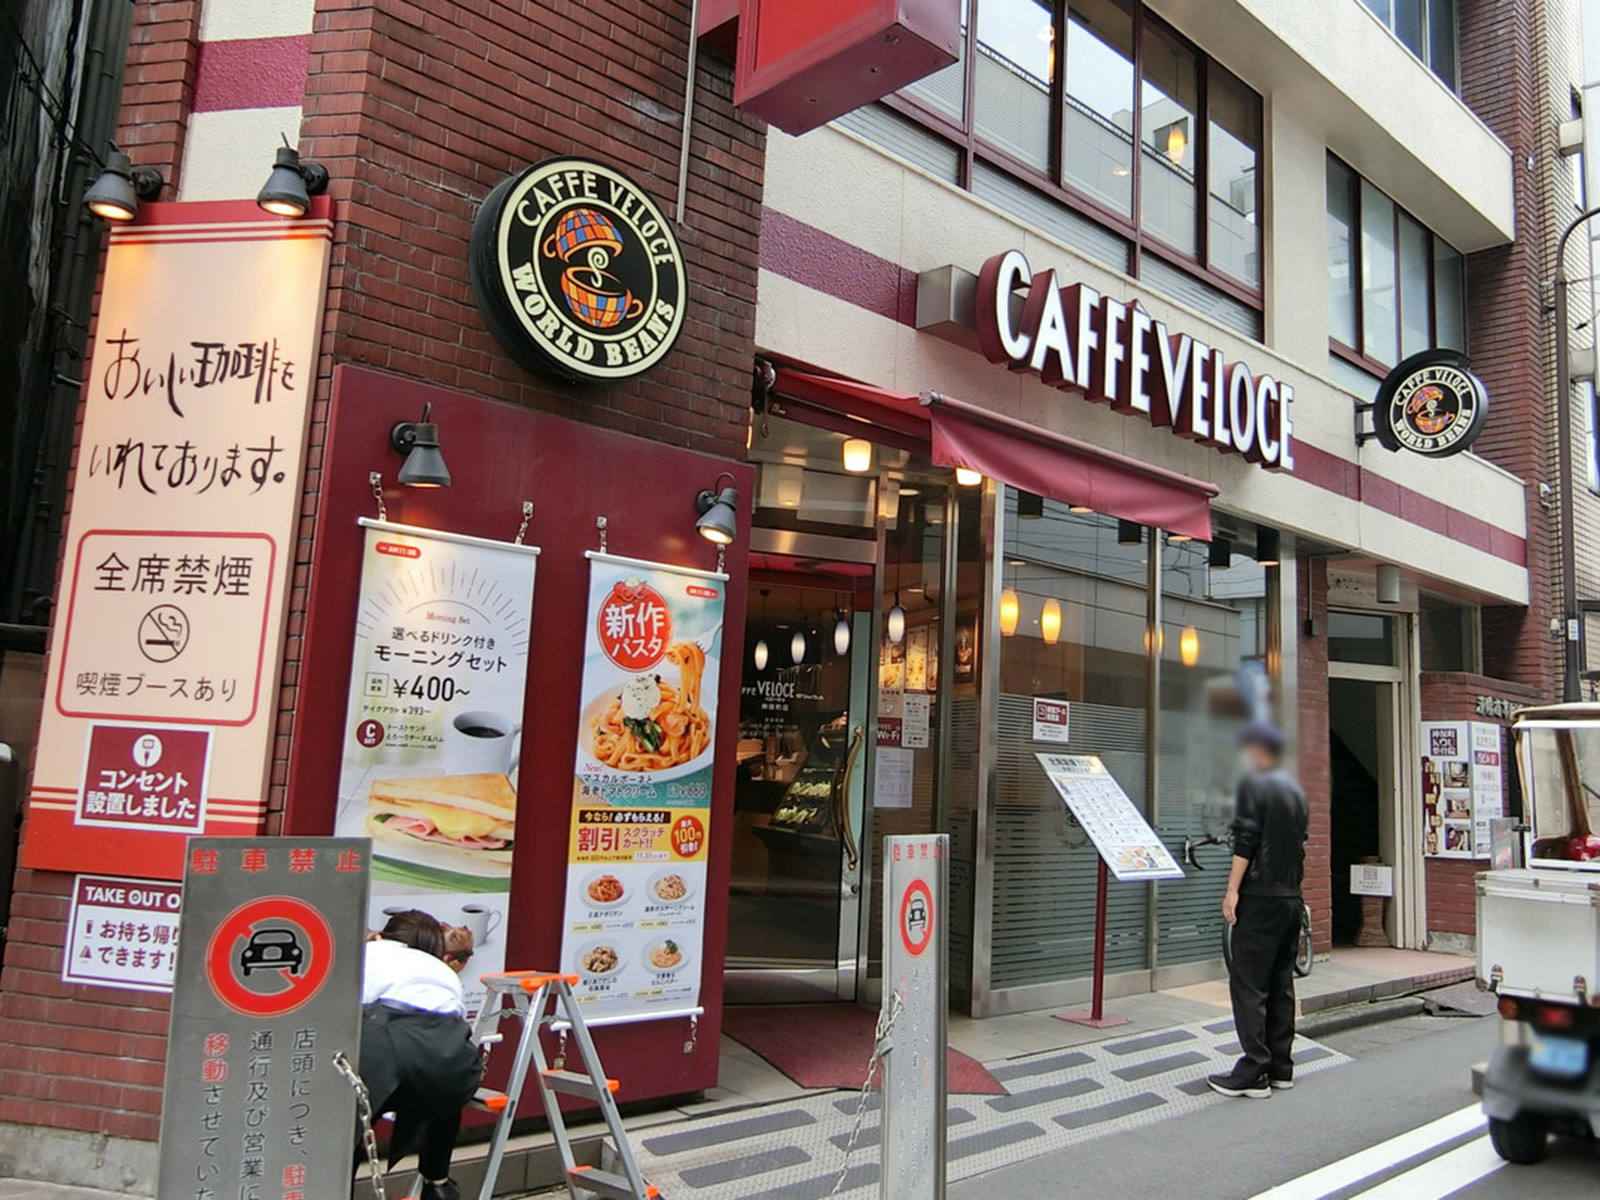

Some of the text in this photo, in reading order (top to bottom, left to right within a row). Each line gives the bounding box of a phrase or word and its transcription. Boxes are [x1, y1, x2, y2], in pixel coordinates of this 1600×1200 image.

[610, 180, 675, 265] VELOCE
[512, 262, 675, 366] WORLD BEANS
[104, 327, 295, 419] おいしい珈琲を
[1154, 319, 1295, 471] VELOCE
[1394, 408, 1472, 449] WORLD BEANS
[89, 435, 286, 495] いれております。
[93, 552, 254, 597] 全席禁煙
[605, 601, 666, 639] 新作
[391, 627, 496, 650] 選べるドリンク付き
[611, 637, 662, 658] パスタ
[374, 645, 508, 674] モーニングセット
[76, 671, 238, 703] 喫煙ブースあり
[757, 680, 796, 699] VELOCE
[366, 723, 376, 738] C
[99, 769, 188, 794] コンセント
[582, 773, 654, 785] マスカルポーネと
[85, 790, 196, 820] 設置しました
[578, 826, 620, 852] 割引
[623, 827, 666, 838] スクラッチ
[190, 847, 363, 875] 駐車禁止
[85, 885, 126, 904] TAKE
[128, 889, 164, 907] OUT
